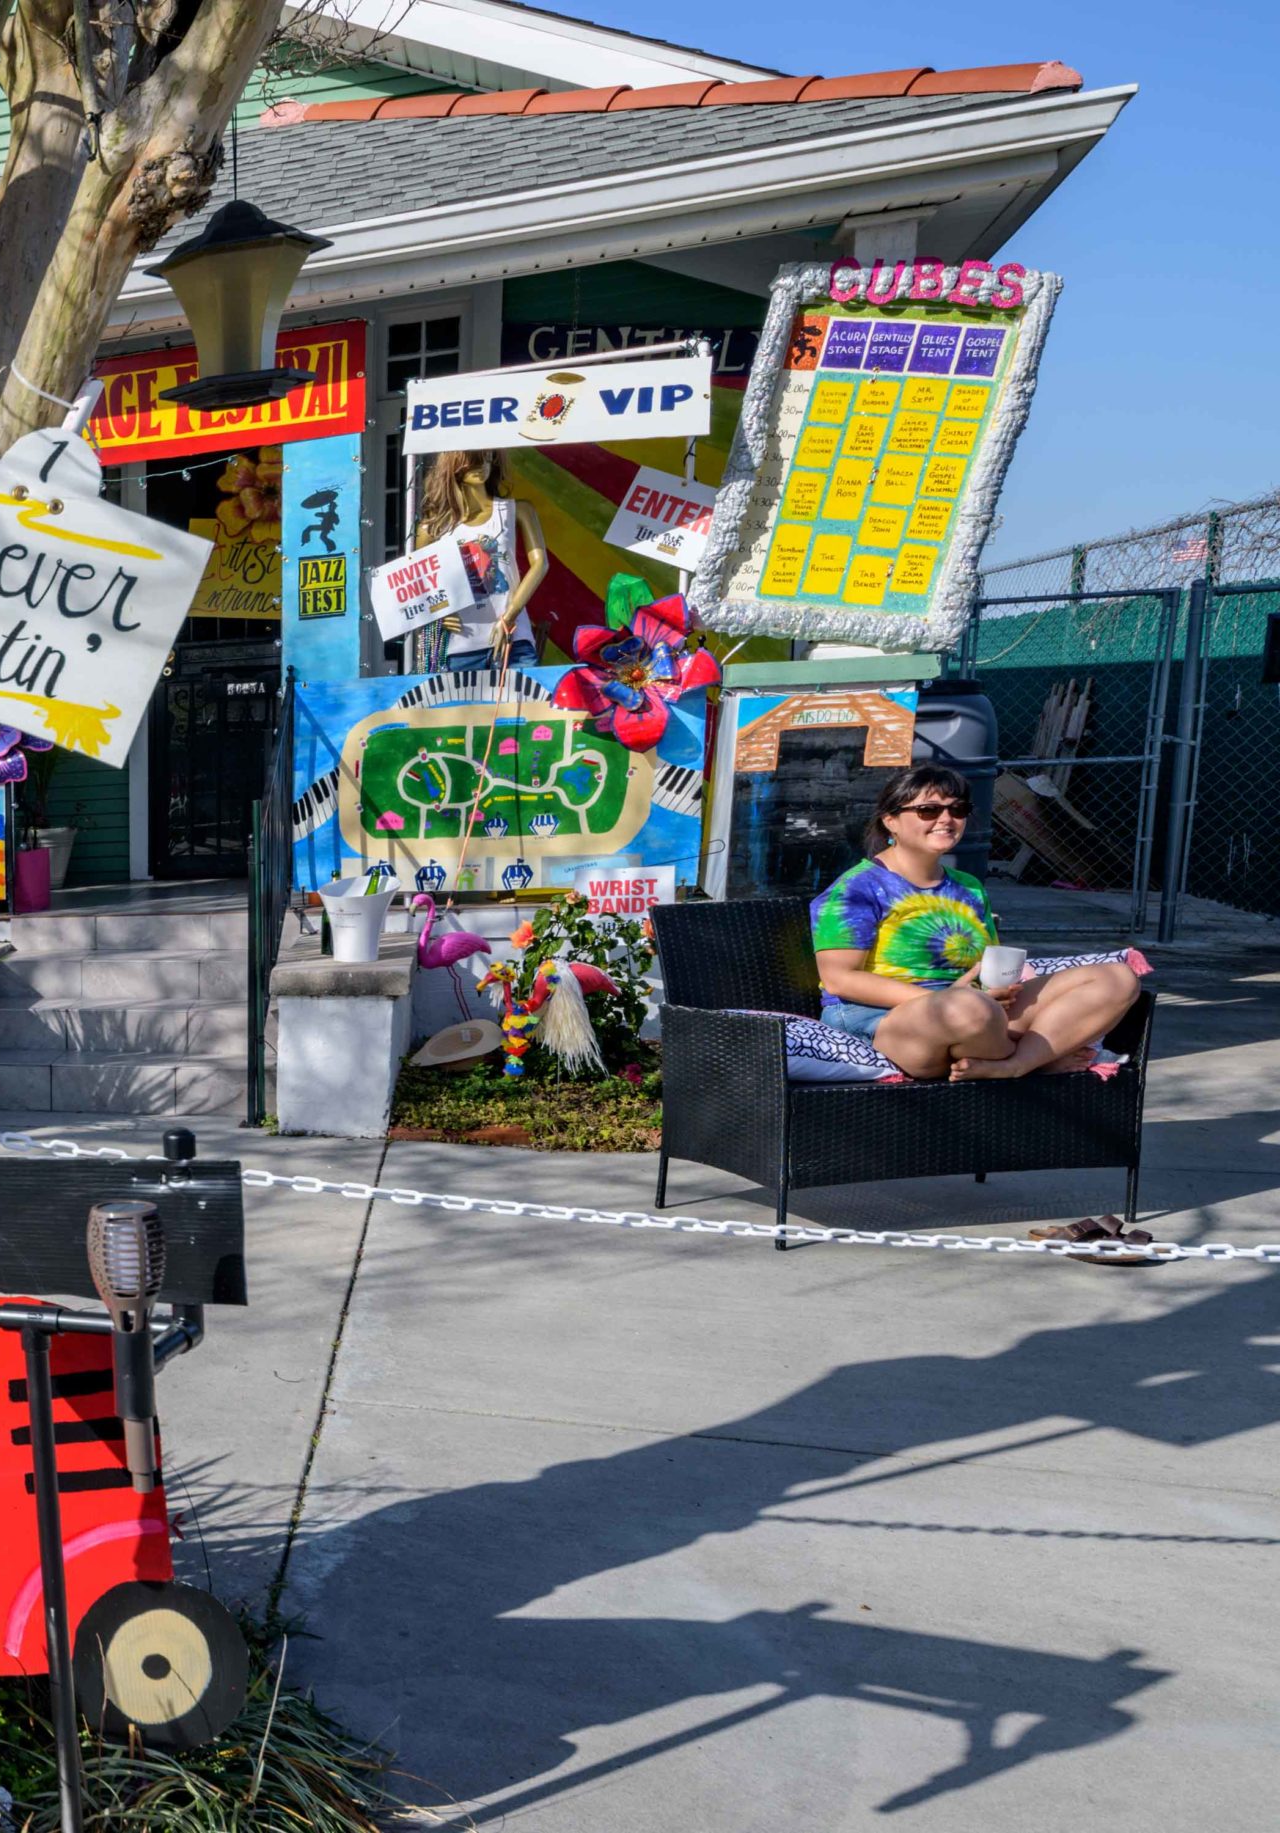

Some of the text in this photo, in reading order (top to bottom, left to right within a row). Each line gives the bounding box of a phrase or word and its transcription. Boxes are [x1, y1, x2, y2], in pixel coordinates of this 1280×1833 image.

[830, 256, 1026, 309] CUBES
[830, 331, 1002, 348] ACURA GENTILLY BLUES GOSPEL
[827, 345, 995, 358] STAGE STAGE TENT TENT
[411, 384, 694, 431] BEER VIP
[836, 476, 862, 486] DIANA
[885, 479, 907, 487] BALL
[836, 488, 857, 498] ROSS
[625, 485, 715, 537] ENTER
[300, 558, 344, 589] JAZZ
[386, 554, 441, 590] INVITE
[396, 572, 439, 604] ONLY
[300, 588, 344, 614] FEST
[790, 709, 854, 724] FAIS DO DO
[588, 878, 658, 897] WRIST
[587, 896, 660, 914] BANDS
